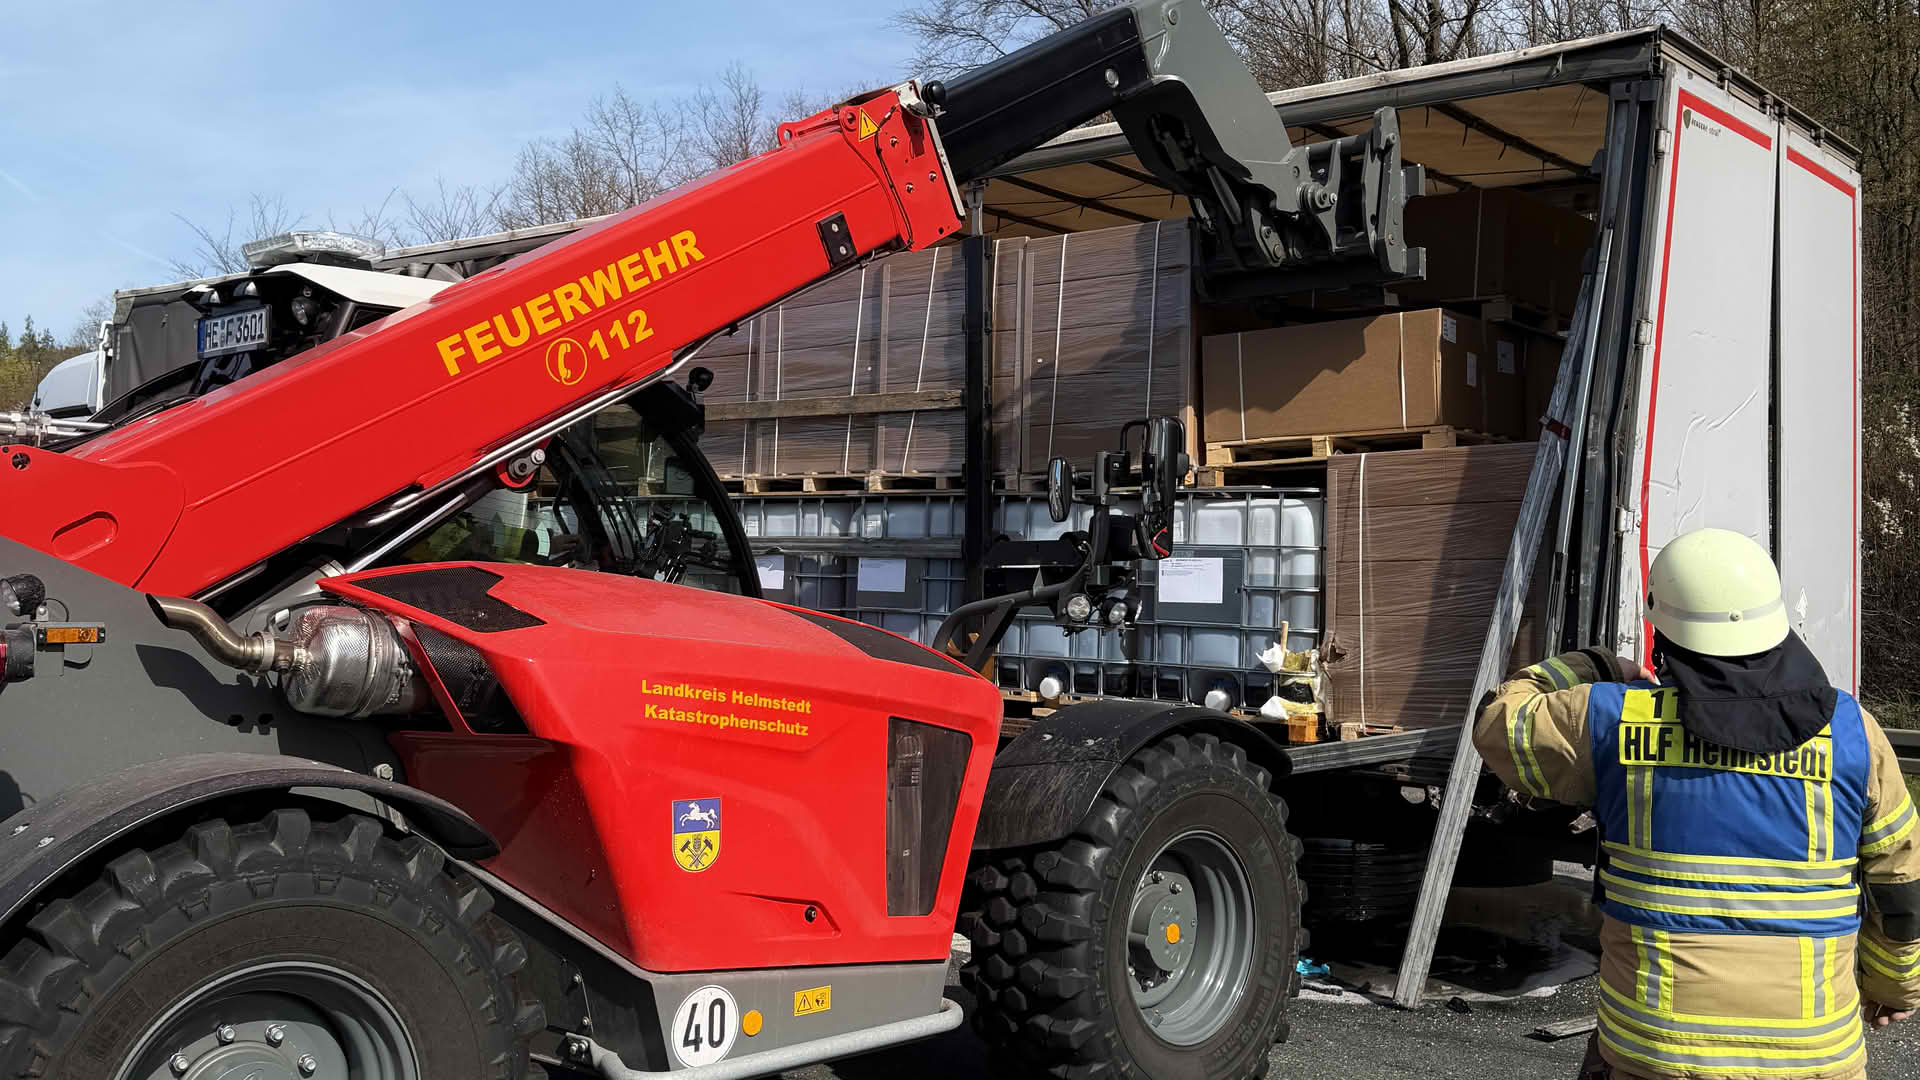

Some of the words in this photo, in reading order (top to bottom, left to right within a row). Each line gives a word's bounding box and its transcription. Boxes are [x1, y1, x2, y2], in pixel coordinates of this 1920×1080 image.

[436, 230, 704, 377] FEUERWEHR
[206, 320, 219, 350] HE
[226, 317, 234, 345] F
[235, 313, 264, 343] 3601
[588, 309, 654, 360] 112
[641, 679, 727, 702] Landkreis
[731, 690, 812, 714] Helmstedt
[644, 703, 809, 737] Katastrophenschutz
[1624, 726, 1673, 762] HLF
[683, 997, 726, 1053] 40
